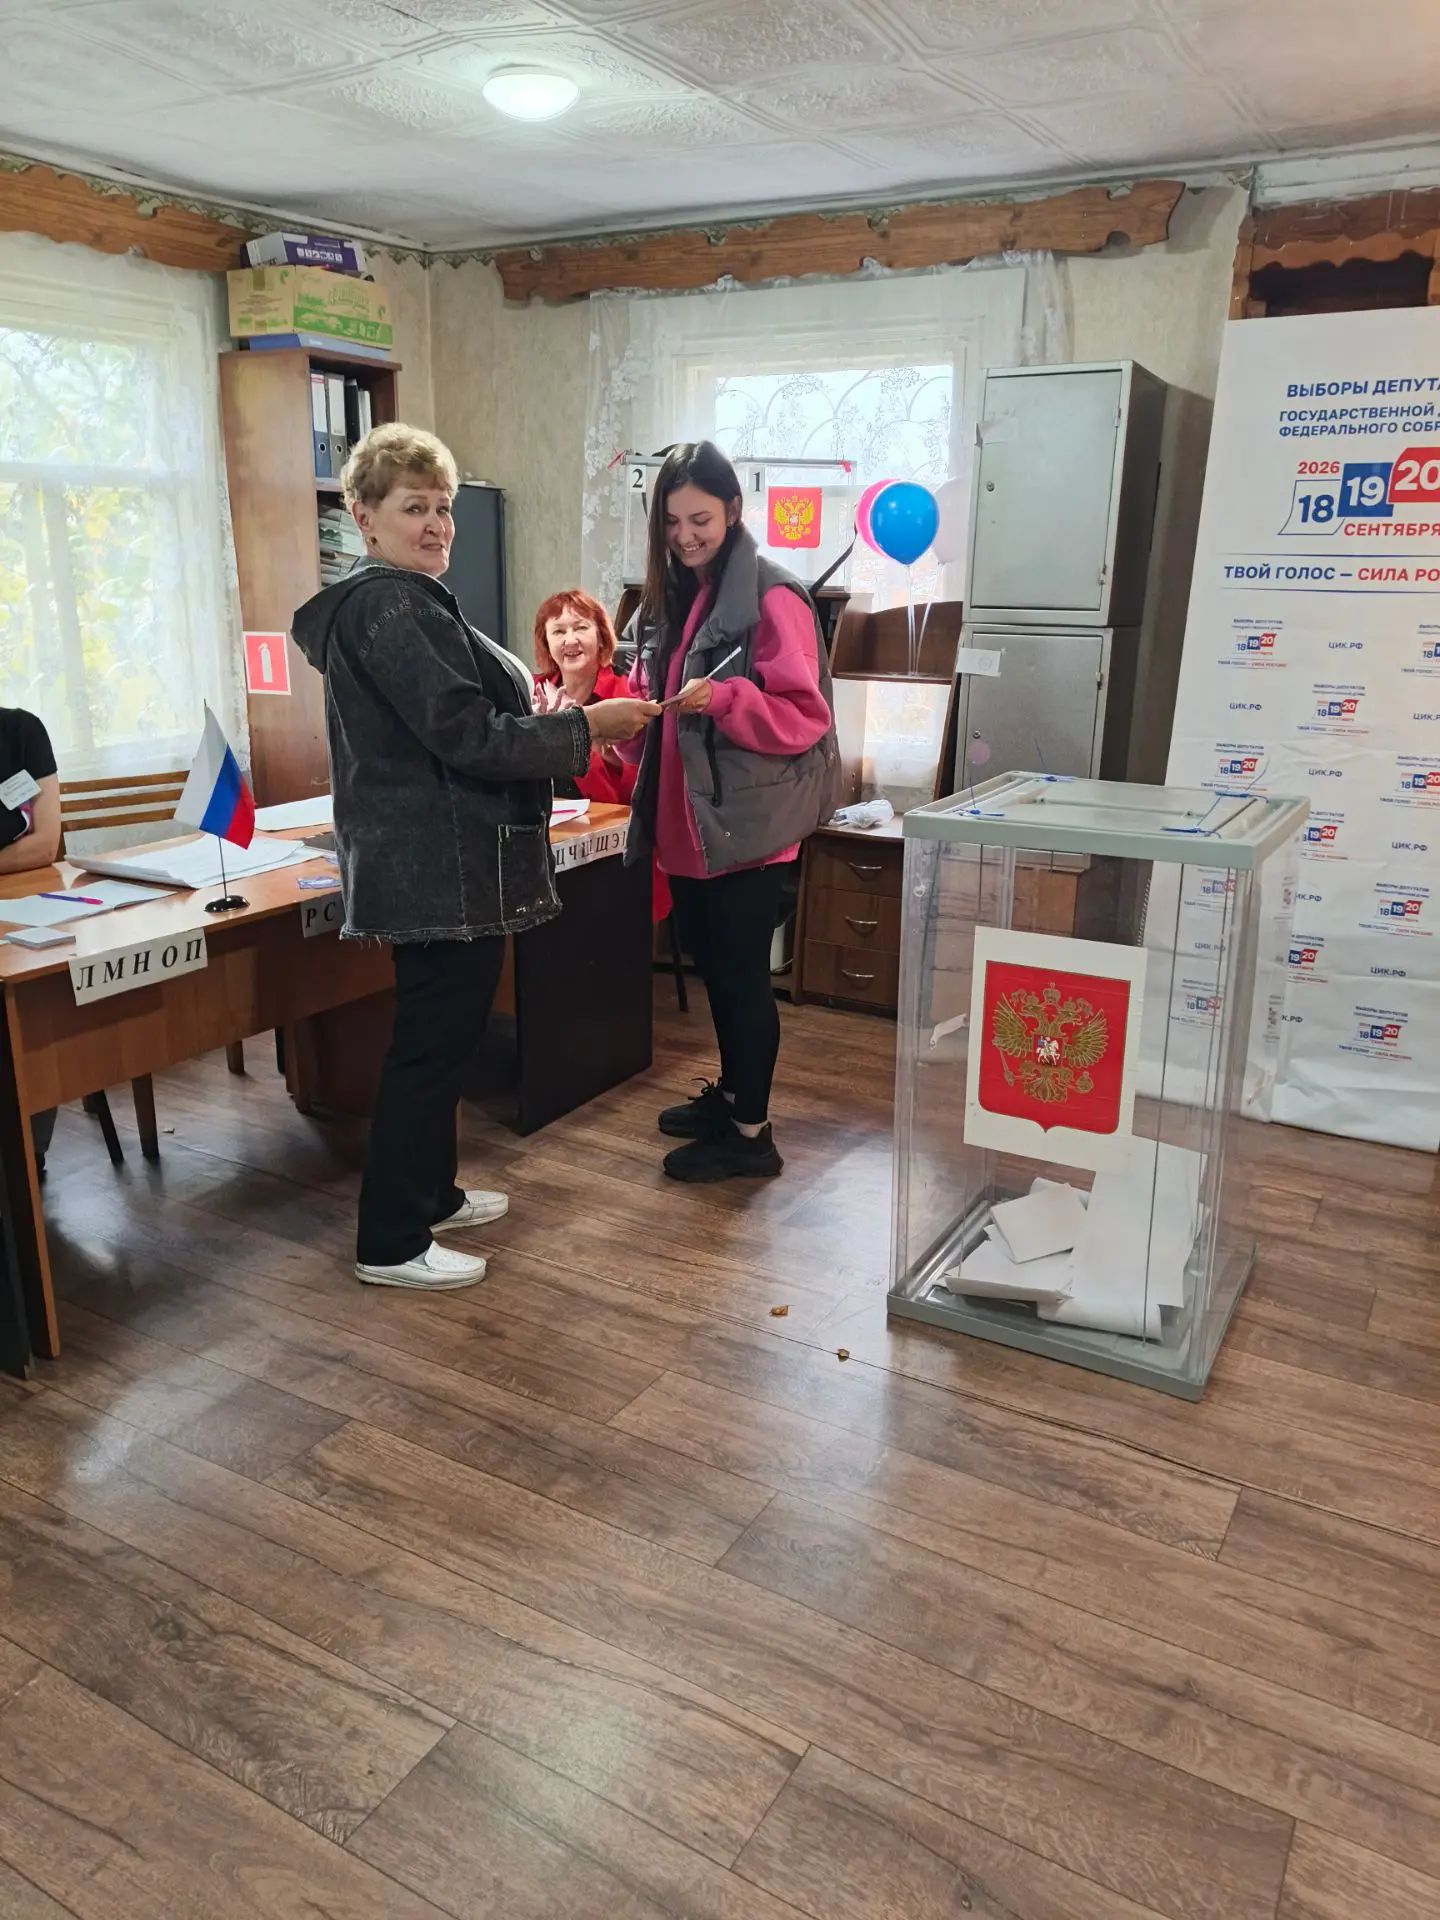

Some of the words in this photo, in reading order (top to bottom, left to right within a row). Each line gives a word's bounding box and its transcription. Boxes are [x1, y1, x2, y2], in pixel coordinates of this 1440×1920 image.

[1287, 381, 1368, 398] ВЫБОРЫ
[1372, 377, 1440, 396] ДЕПУТ
[1279, 402, 1434, 422] ГОСУДАРСТВЕННОЙ
[1279, 422, 1398, 438] ФЕДЕРАЛЬНОГО
[1297, 461, 1340, 474] 2026
[632, 468, 643, 489] 2
[752, 471, 761, 492] 1
[1298, 495, 1334, 523] 18
[1347, 475, 1385, 507] 19
[1394, 459, 1440, 491] 20
[1224, 563, 1270, 580] ТВОЙ
[1275, 566, 1335, 580] ГОЛОС
[1357, 568, 1409, 581] СИЛА
[1260, 636, 1273, 645] 20
[1243, 760, 1255, 769] 20
[1392, 904, 1403, 913] 19
[1406, 902, 1419, 912] 20
[1302, 951, 1315, 960] 20
[1385, 1027, 1398, 1036] 20
